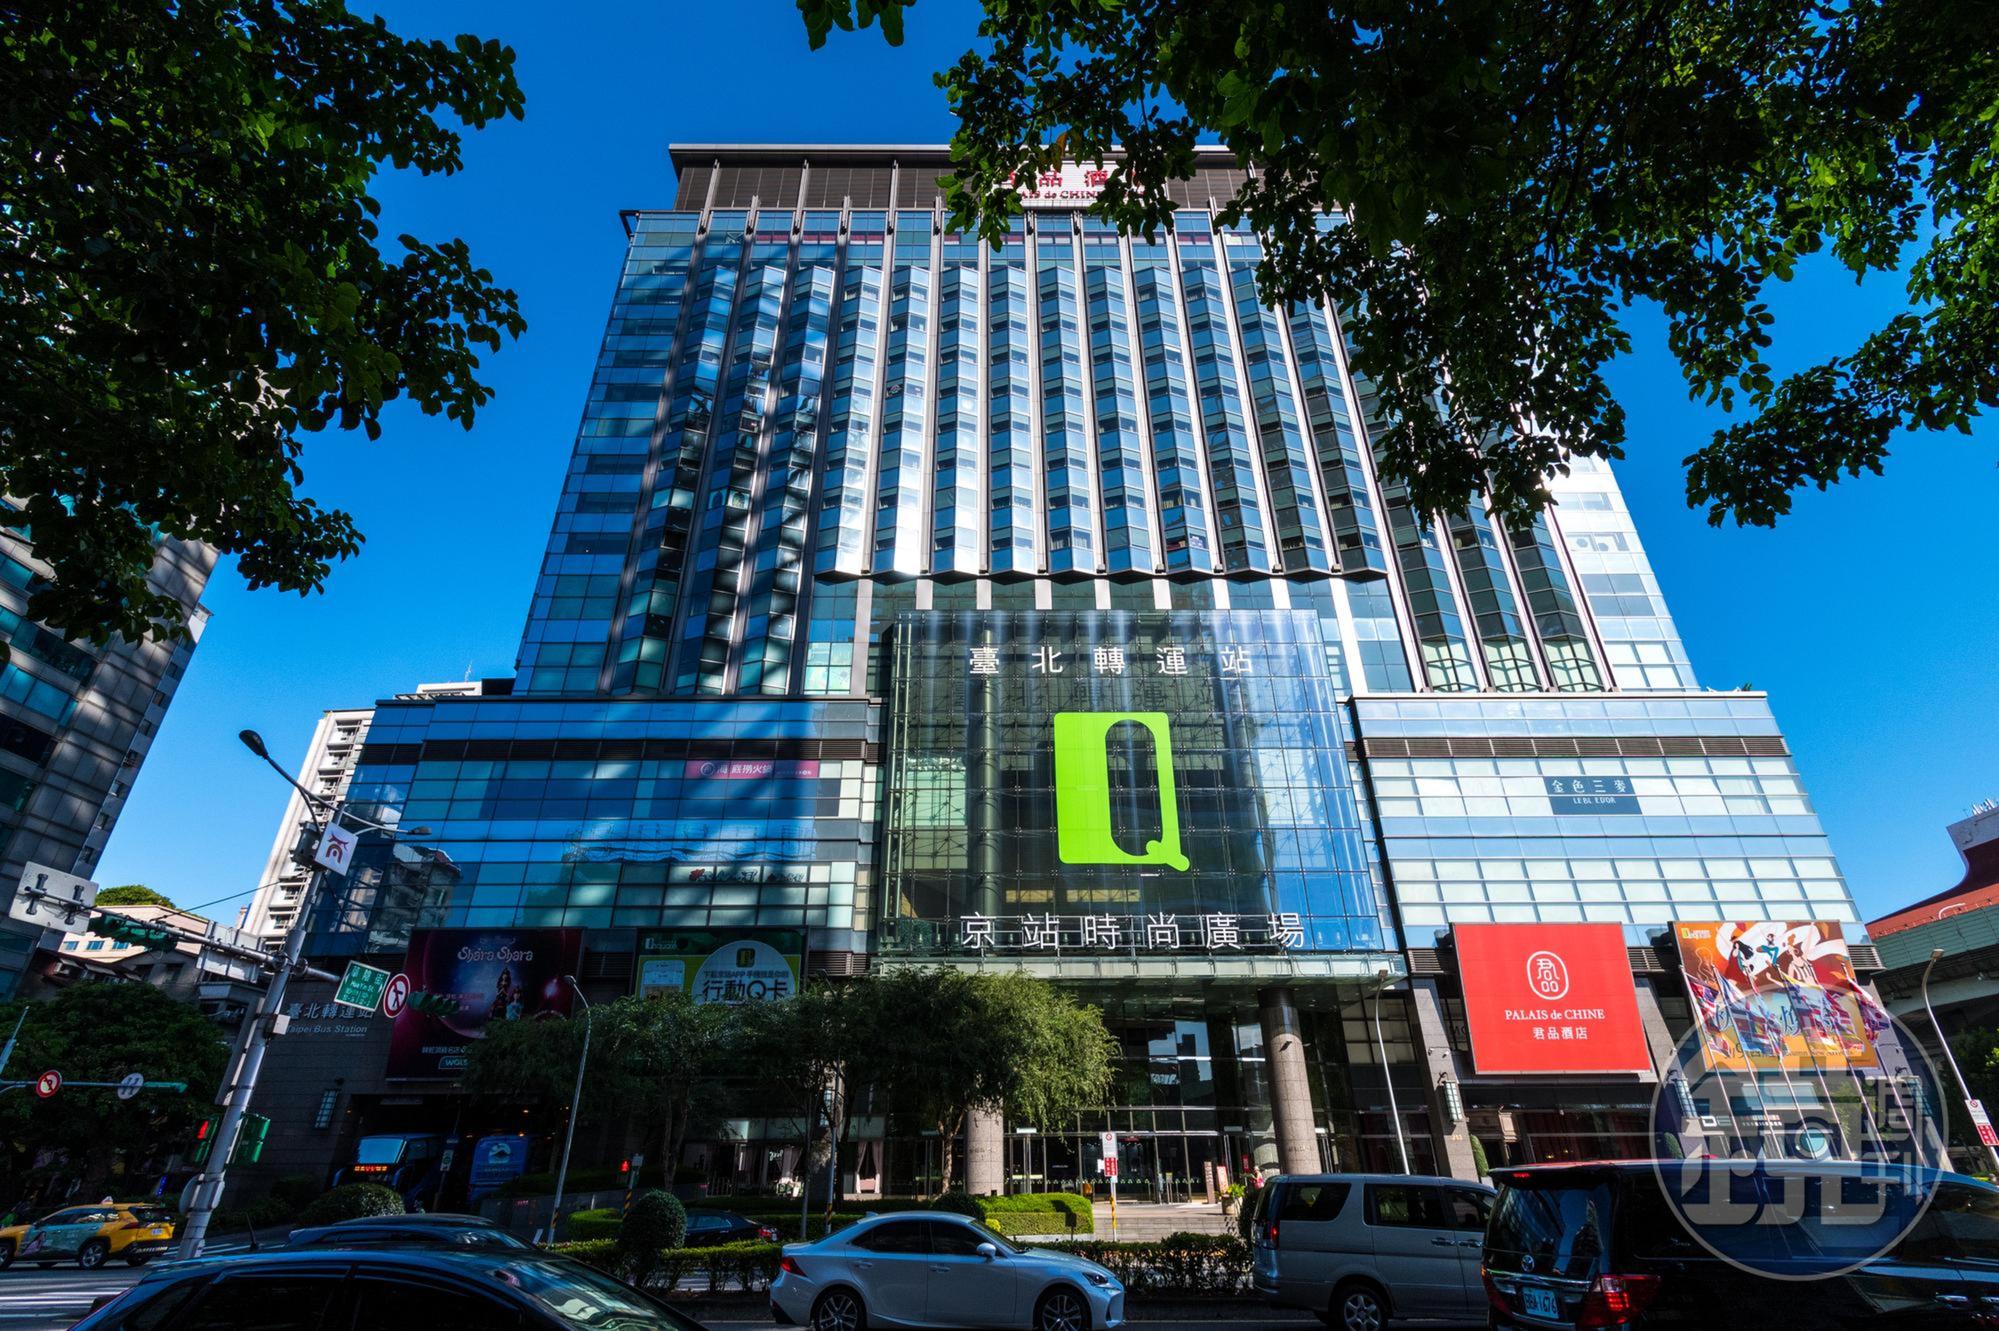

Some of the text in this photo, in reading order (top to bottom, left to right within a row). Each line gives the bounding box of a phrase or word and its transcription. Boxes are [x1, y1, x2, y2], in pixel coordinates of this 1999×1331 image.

[1059, 190, 1100, 199] CHIN
[969, 646, 1252, 675] 臺北轉運站
[1552, 779, 1626, 793] 金色三麥
[960, 911, 1305, 950] 京站時尚廣場
[1504, 1008, 1605, 1020] PALAIS de CHINE
[314, 1024, 331, 1033] Bus
[335, 1024, 368, 1033] Station
[1533, 1026, 1588, 1040] 君品酒店
